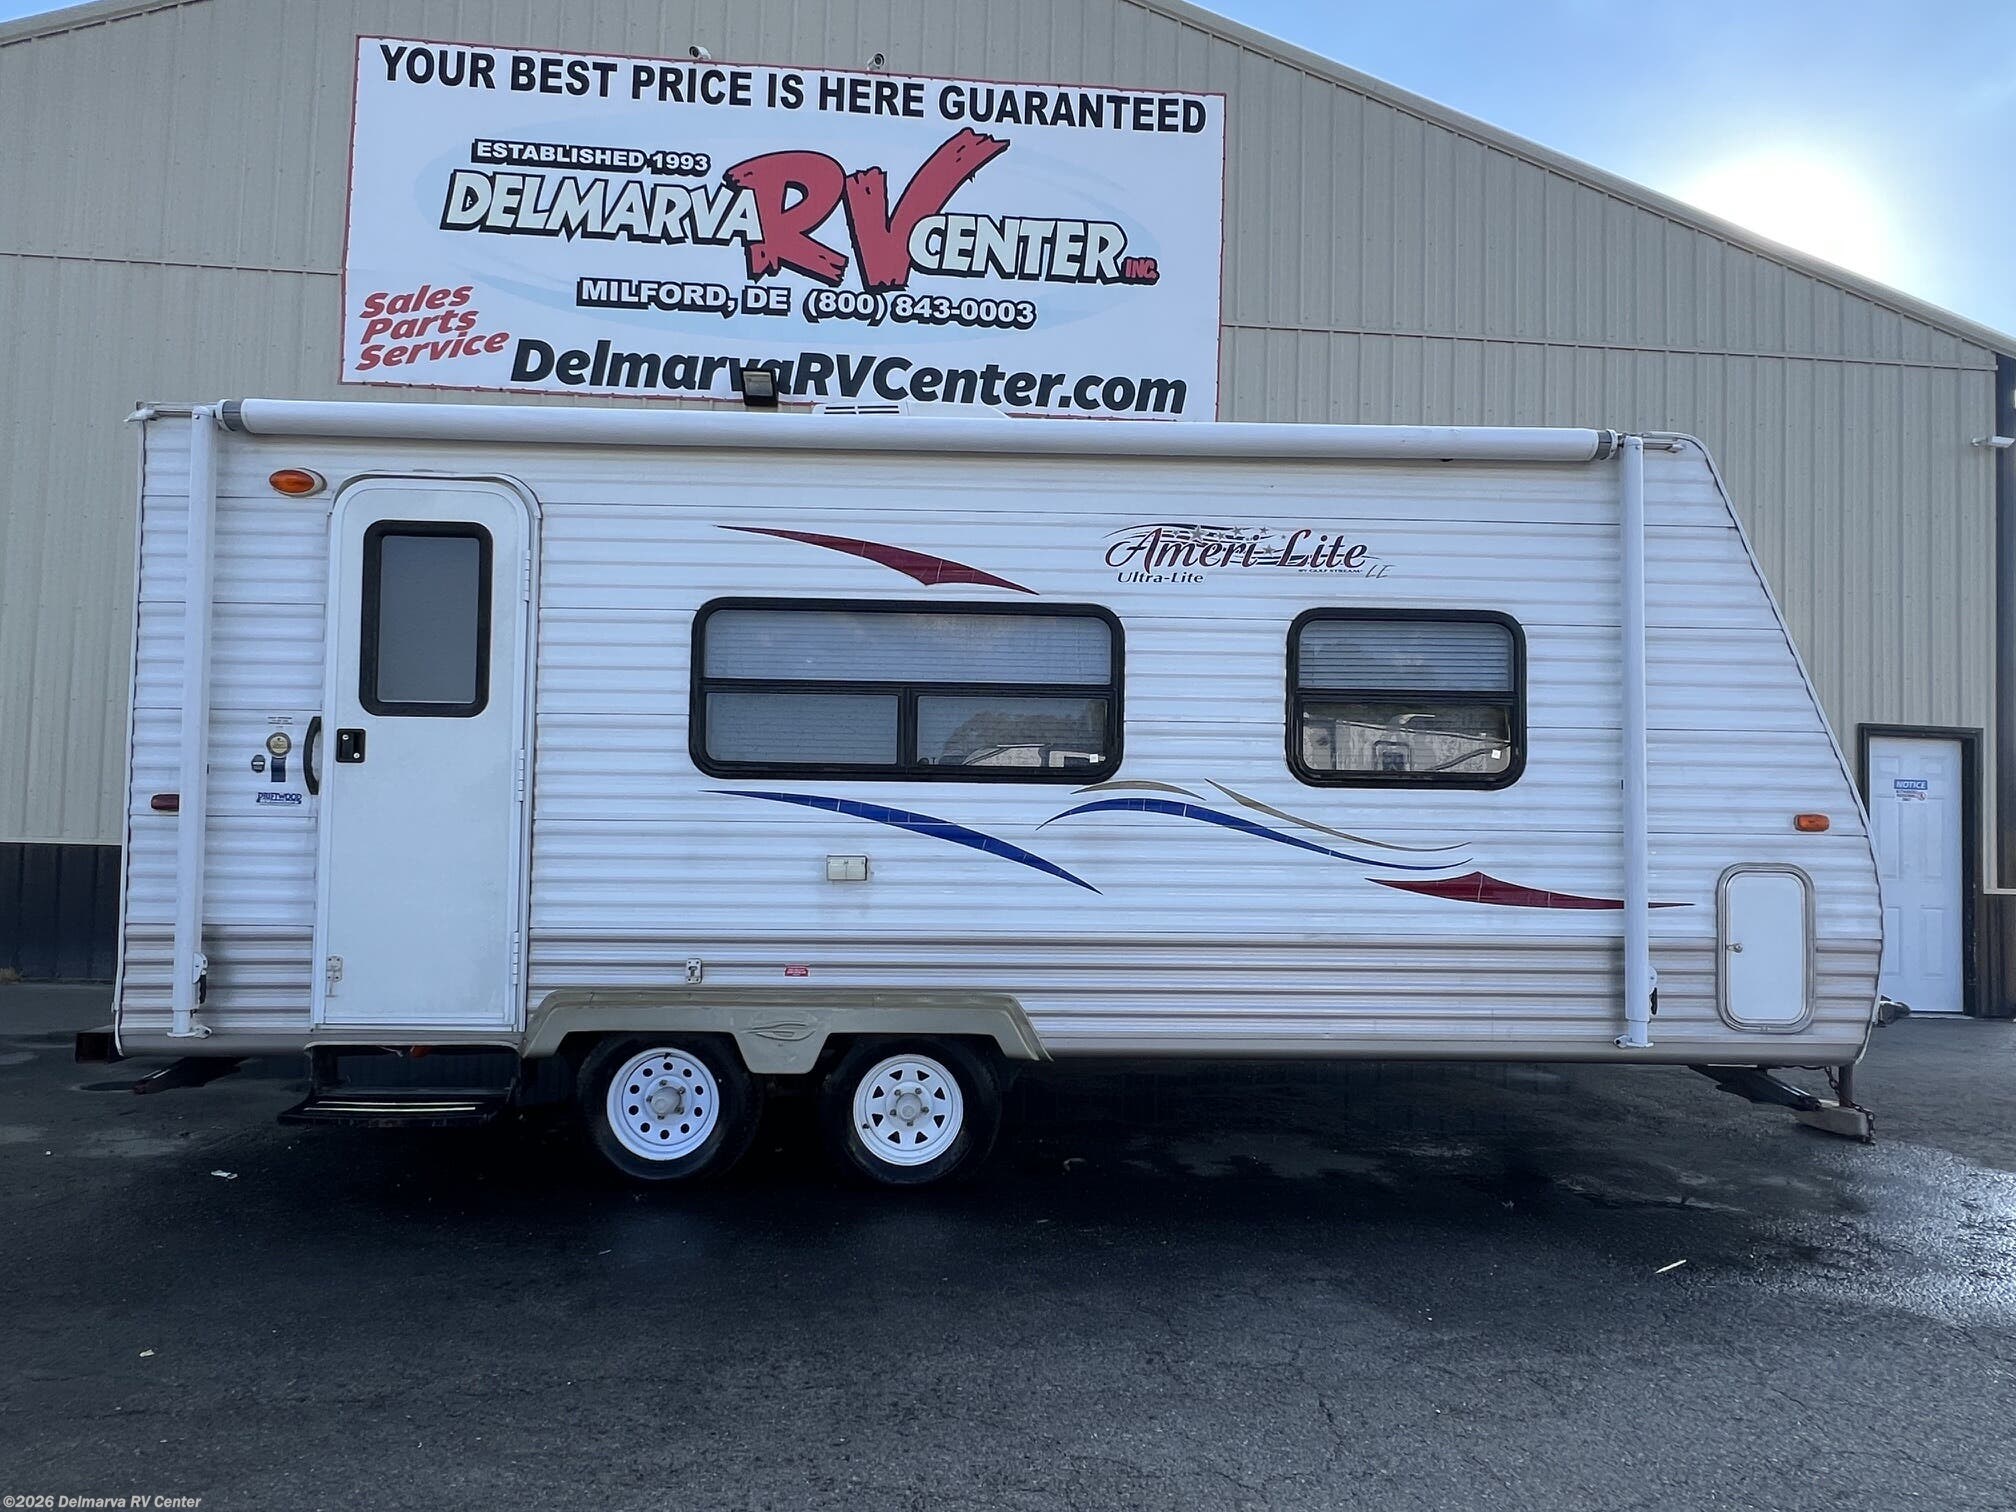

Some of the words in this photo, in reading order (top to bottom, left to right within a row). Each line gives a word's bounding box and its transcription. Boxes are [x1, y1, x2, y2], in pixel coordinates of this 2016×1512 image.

[380, 44, 496, 90] YOUR
[510, 55, 617, 99] BEST
[632, 65, 752, 107] PRICE
[768, 73, 805, 110] IS
[818, 76, 925, 117] HERE
[938, 85, 1207, 133] GUARANTEED
[474, 140, 646, 170] ESTABLISHED
[651, 153, 709, 172] 1993
[444, 170, 766, 243] DELMARVA
[723, 127, 1010, 289] RV
[908, 213, 1128, 284] CENTER
[359, 285, 473, 318] Sales
[578, 278, 736, 315] MILFORD,
[743, 286, 790, 312] DE
[806, 289, 887, 324] (800)
[894, 296, 1036, 328] 843-0003
[361, 309, 478, 344] Parts
[355, 332, 511, 370] Service
[511, 338, 1188, 415] DelmarvaRVCenter.com
[1117, 571, 1204, 583] Ultra-Lite
[1896, 781, 1926, 789] NOTICE
